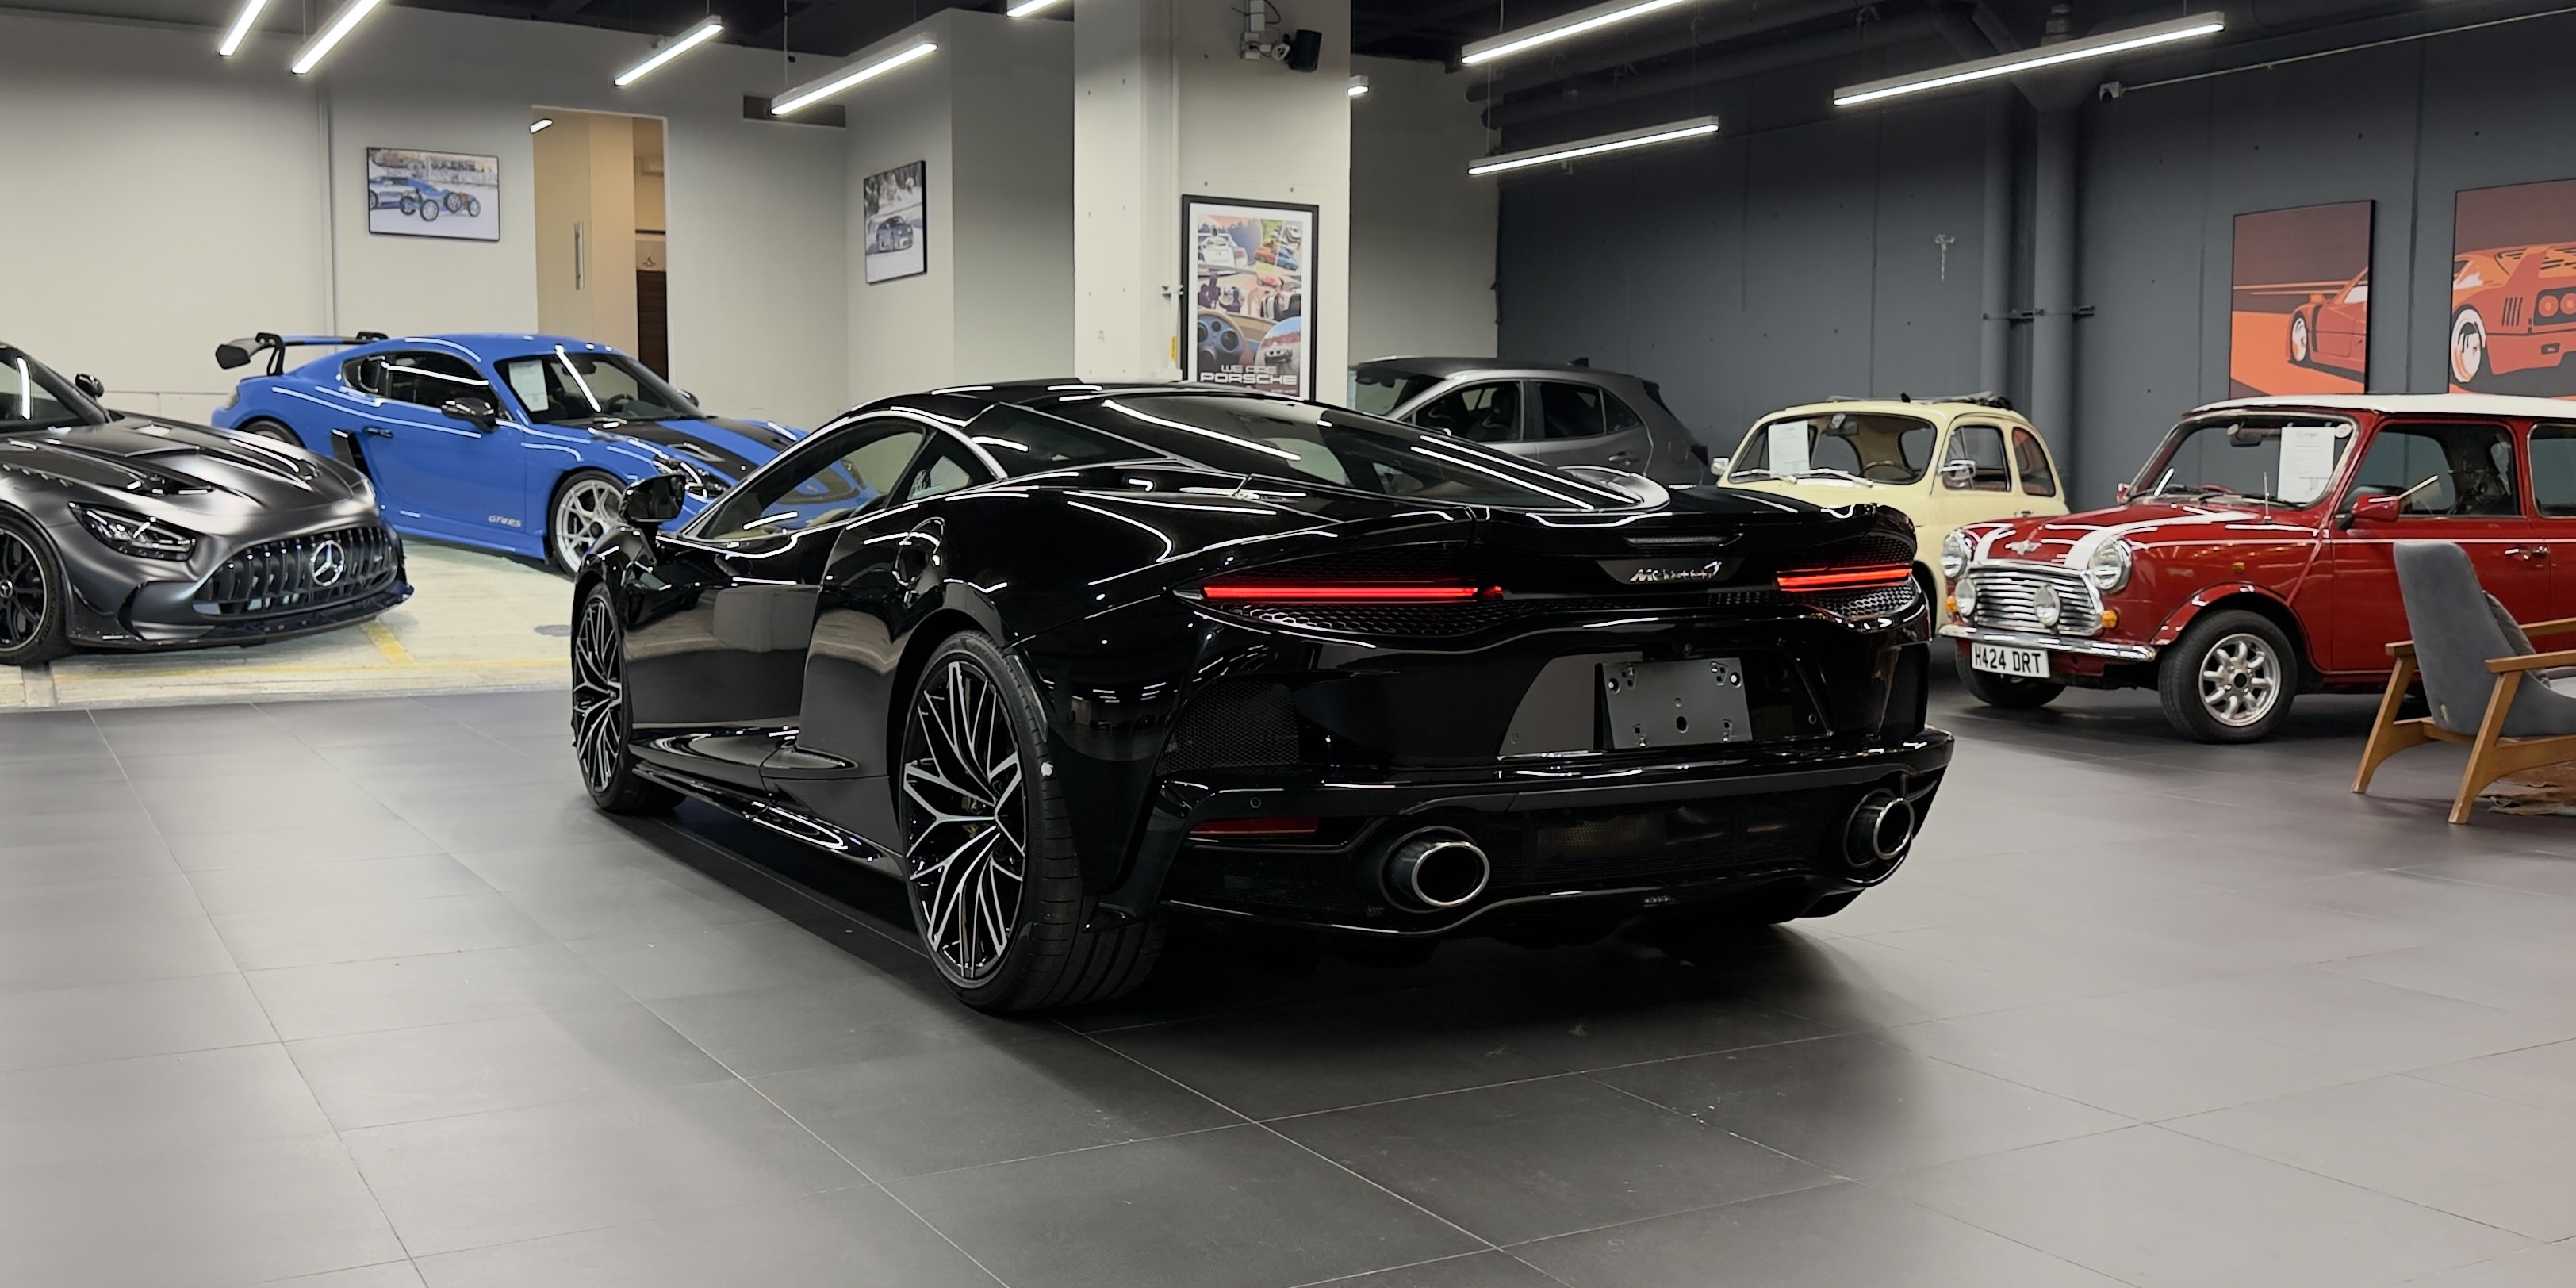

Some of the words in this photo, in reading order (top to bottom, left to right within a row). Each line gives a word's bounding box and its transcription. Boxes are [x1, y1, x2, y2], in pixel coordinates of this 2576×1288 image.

[1221, 364, 1243, 374] WE
[1245, 366, 1277, 374] ARE
[1200, 372, 1298, 385] PORSCHE
[1975, 646, 2007, 670] H424
[2012, 651, 2041, 673] DRT
